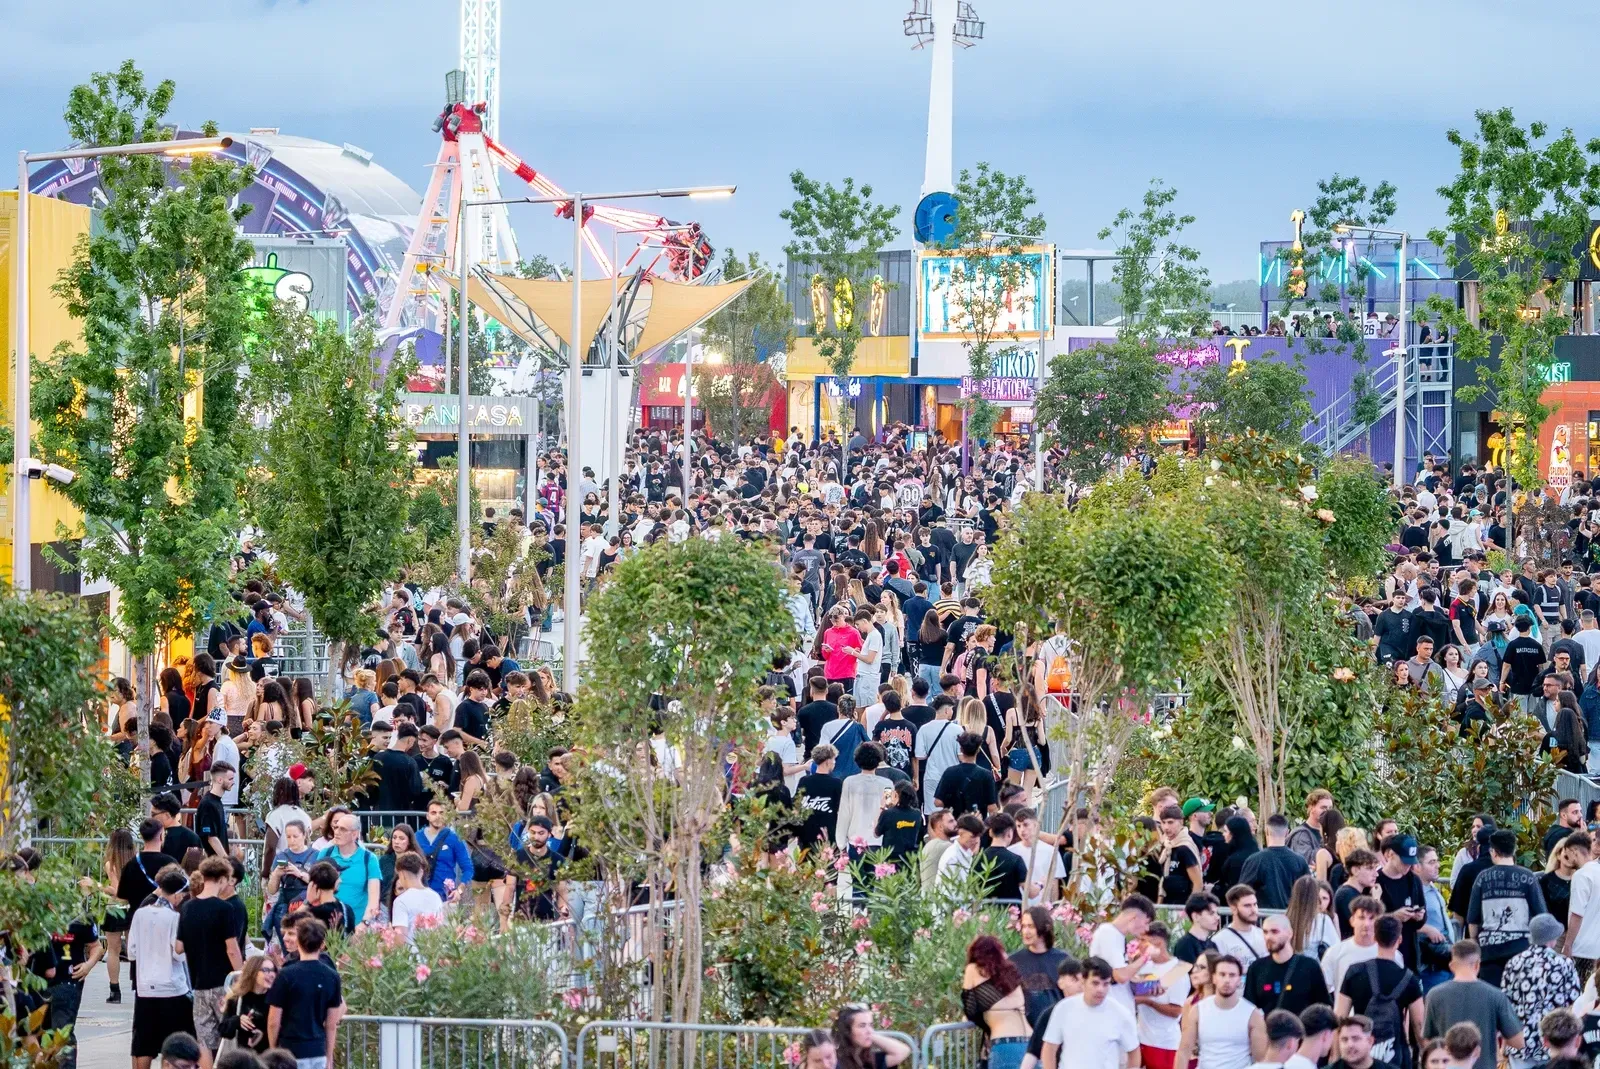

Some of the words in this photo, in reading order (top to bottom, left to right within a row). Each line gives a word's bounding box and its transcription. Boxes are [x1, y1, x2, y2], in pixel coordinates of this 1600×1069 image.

[1364, 324, 1375, 336] 26
[658, 376, 671, 393] BAR
[991, 377, 1029, 400] FACTORY
[550, 491, 558, 503] 4
